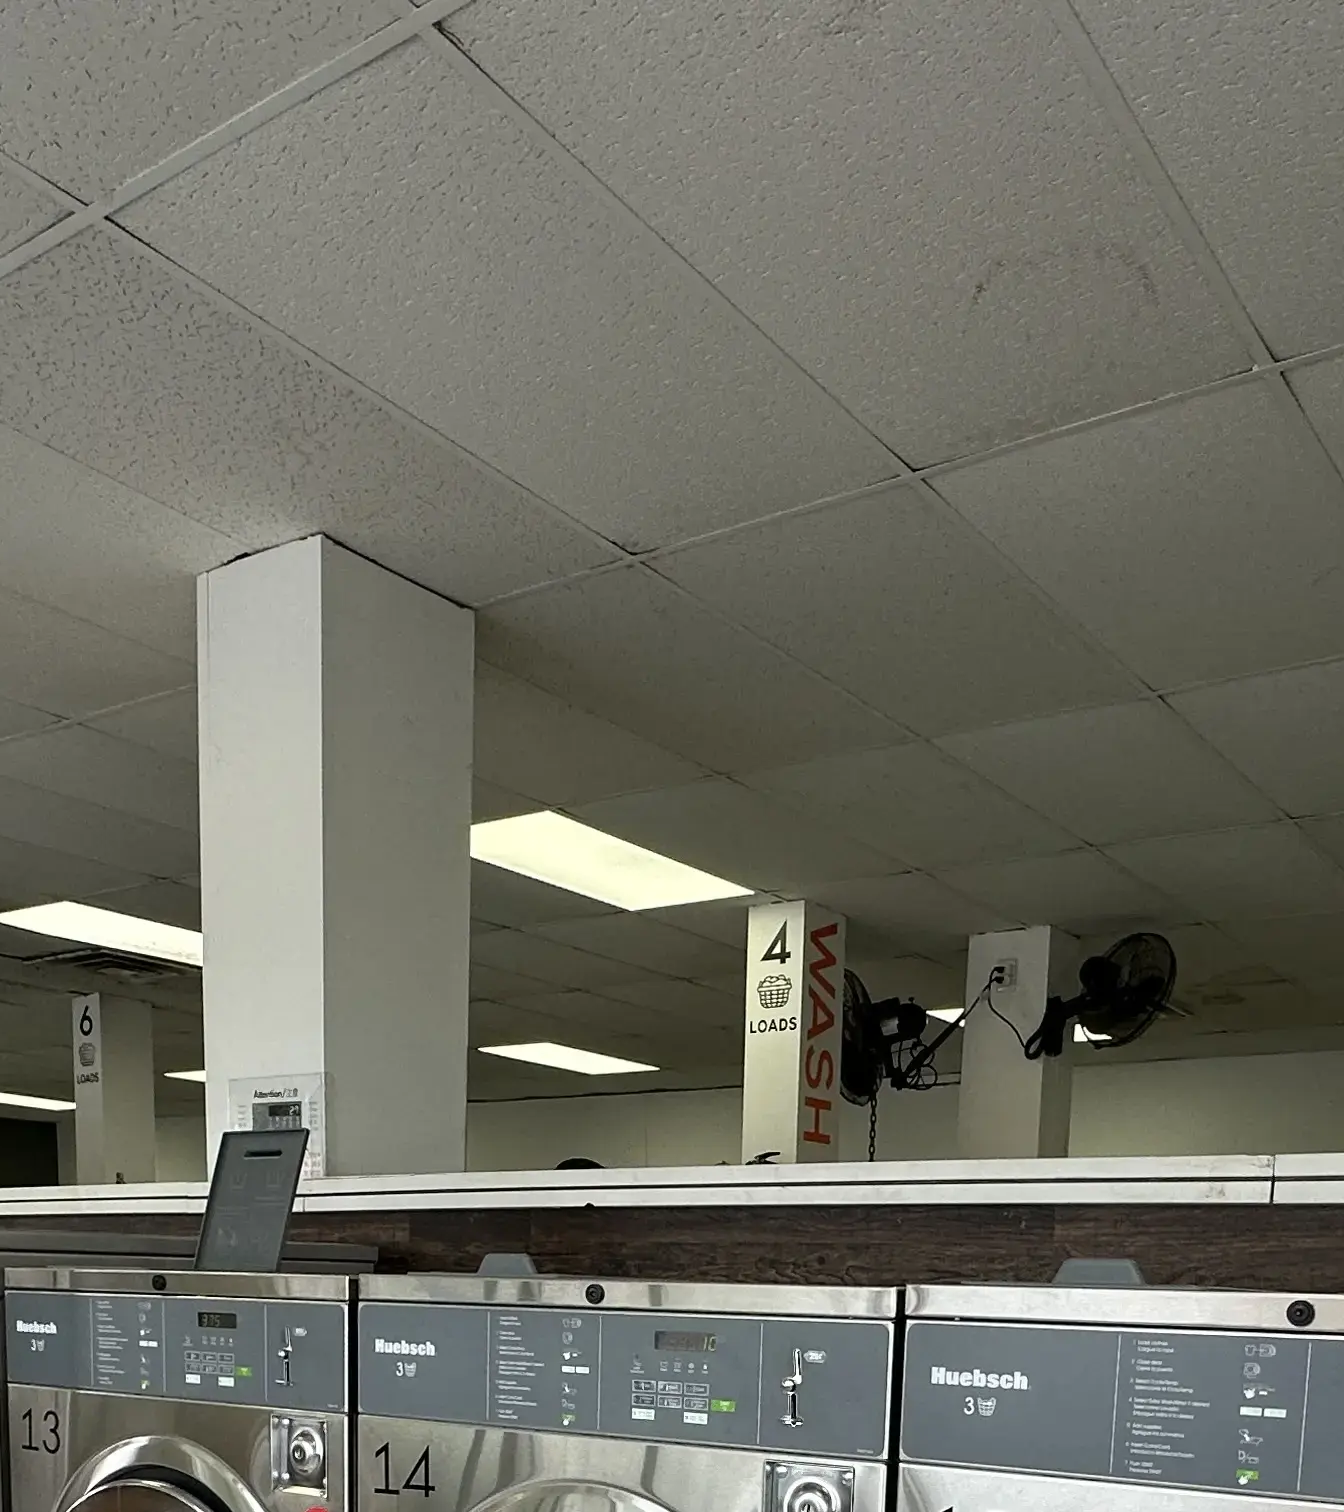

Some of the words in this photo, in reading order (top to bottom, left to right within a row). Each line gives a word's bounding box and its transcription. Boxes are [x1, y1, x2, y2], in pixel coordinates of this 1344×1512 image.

[760, 918, 791, 964] 4
[80, 1005, 93, 1036] 6
[749, 1016, 797, 1034] LOADS
[803, 922, 838, 1145] WASH
[374, 1338, 436, 1357] Huebsch
[396, 1361, 404, 1377] 3
[930, 1366, 1029, 1391] Huebsch
[963, 1396, 975, 1415] 3
[21, 1408, 61, 1454] 13
[374, 1441, 436, 1498] 14
